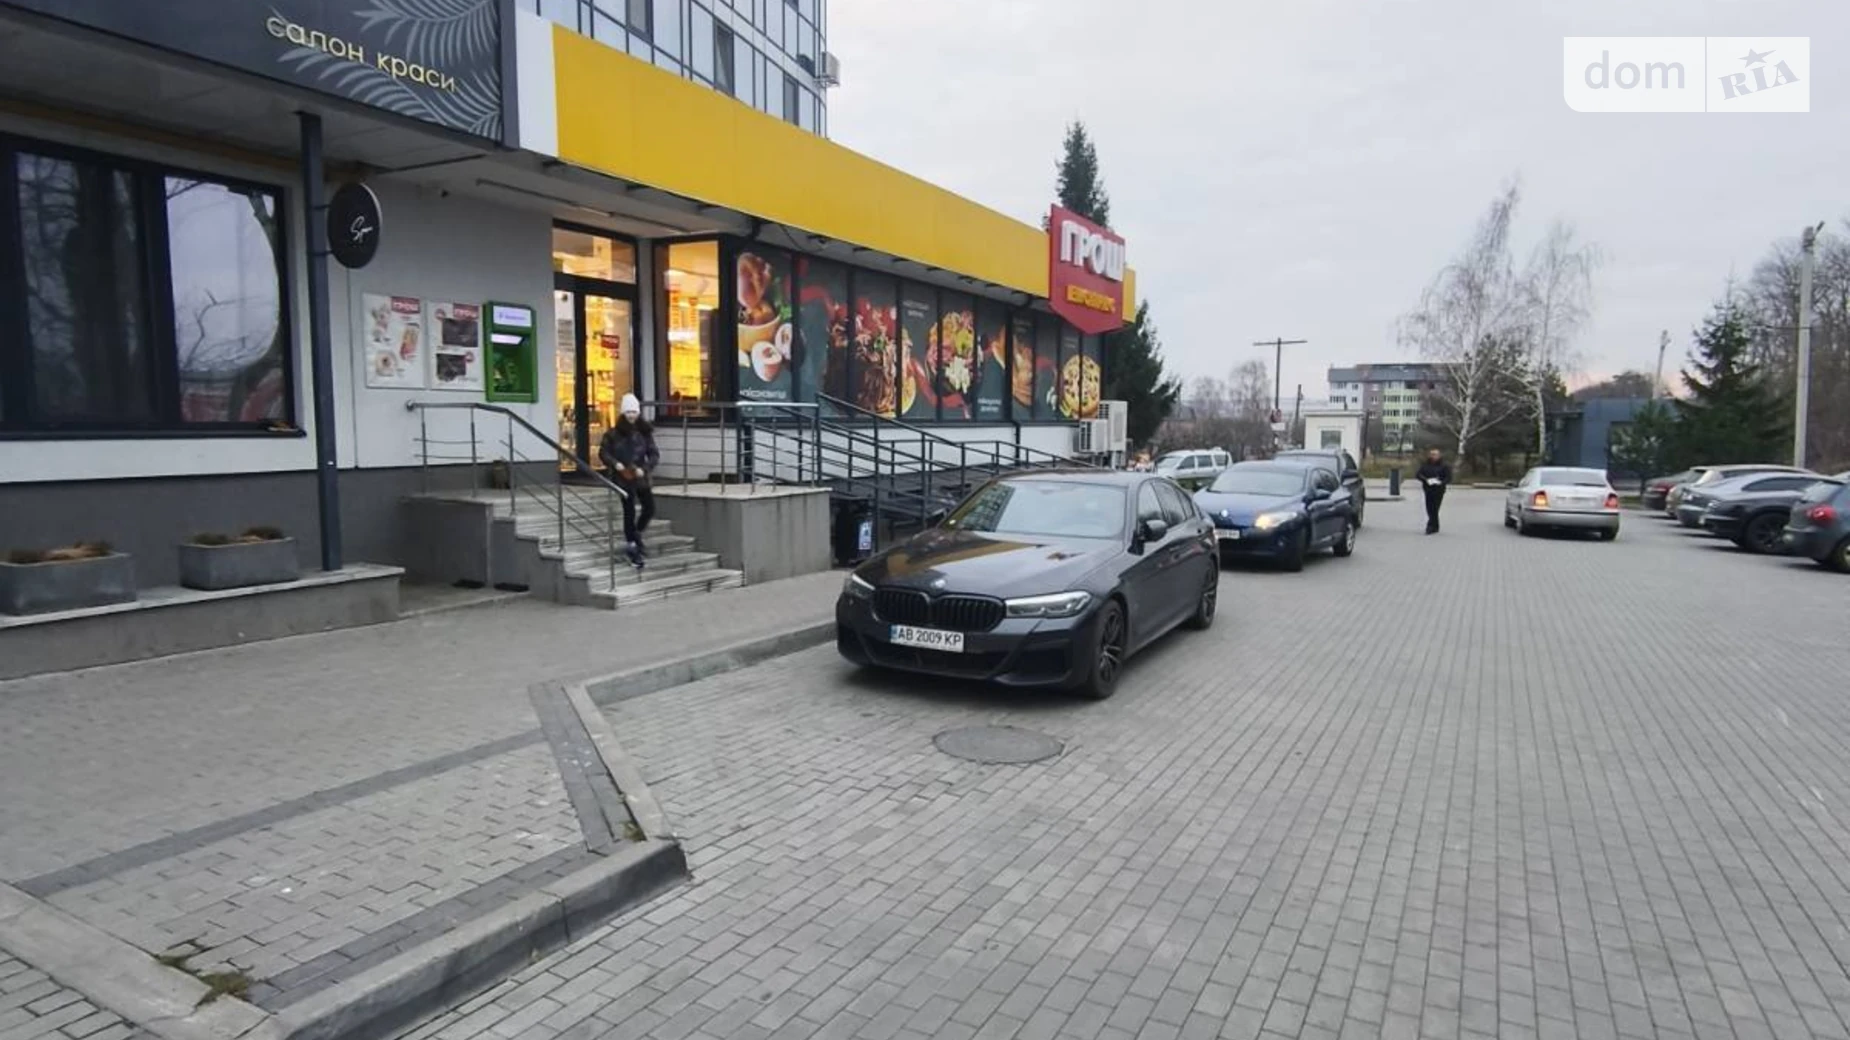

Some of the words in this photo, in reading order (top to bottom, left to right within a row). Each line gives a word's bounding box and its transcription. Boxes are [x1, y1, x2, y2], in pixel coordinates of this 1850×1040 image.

[266, 16, 364, 63] салон
[376, 52, 455, 91] краси
[898, 627, 914, 641] AB
[916, 630, 942, 644] 2009
[944, 632, 961, 646] KP
